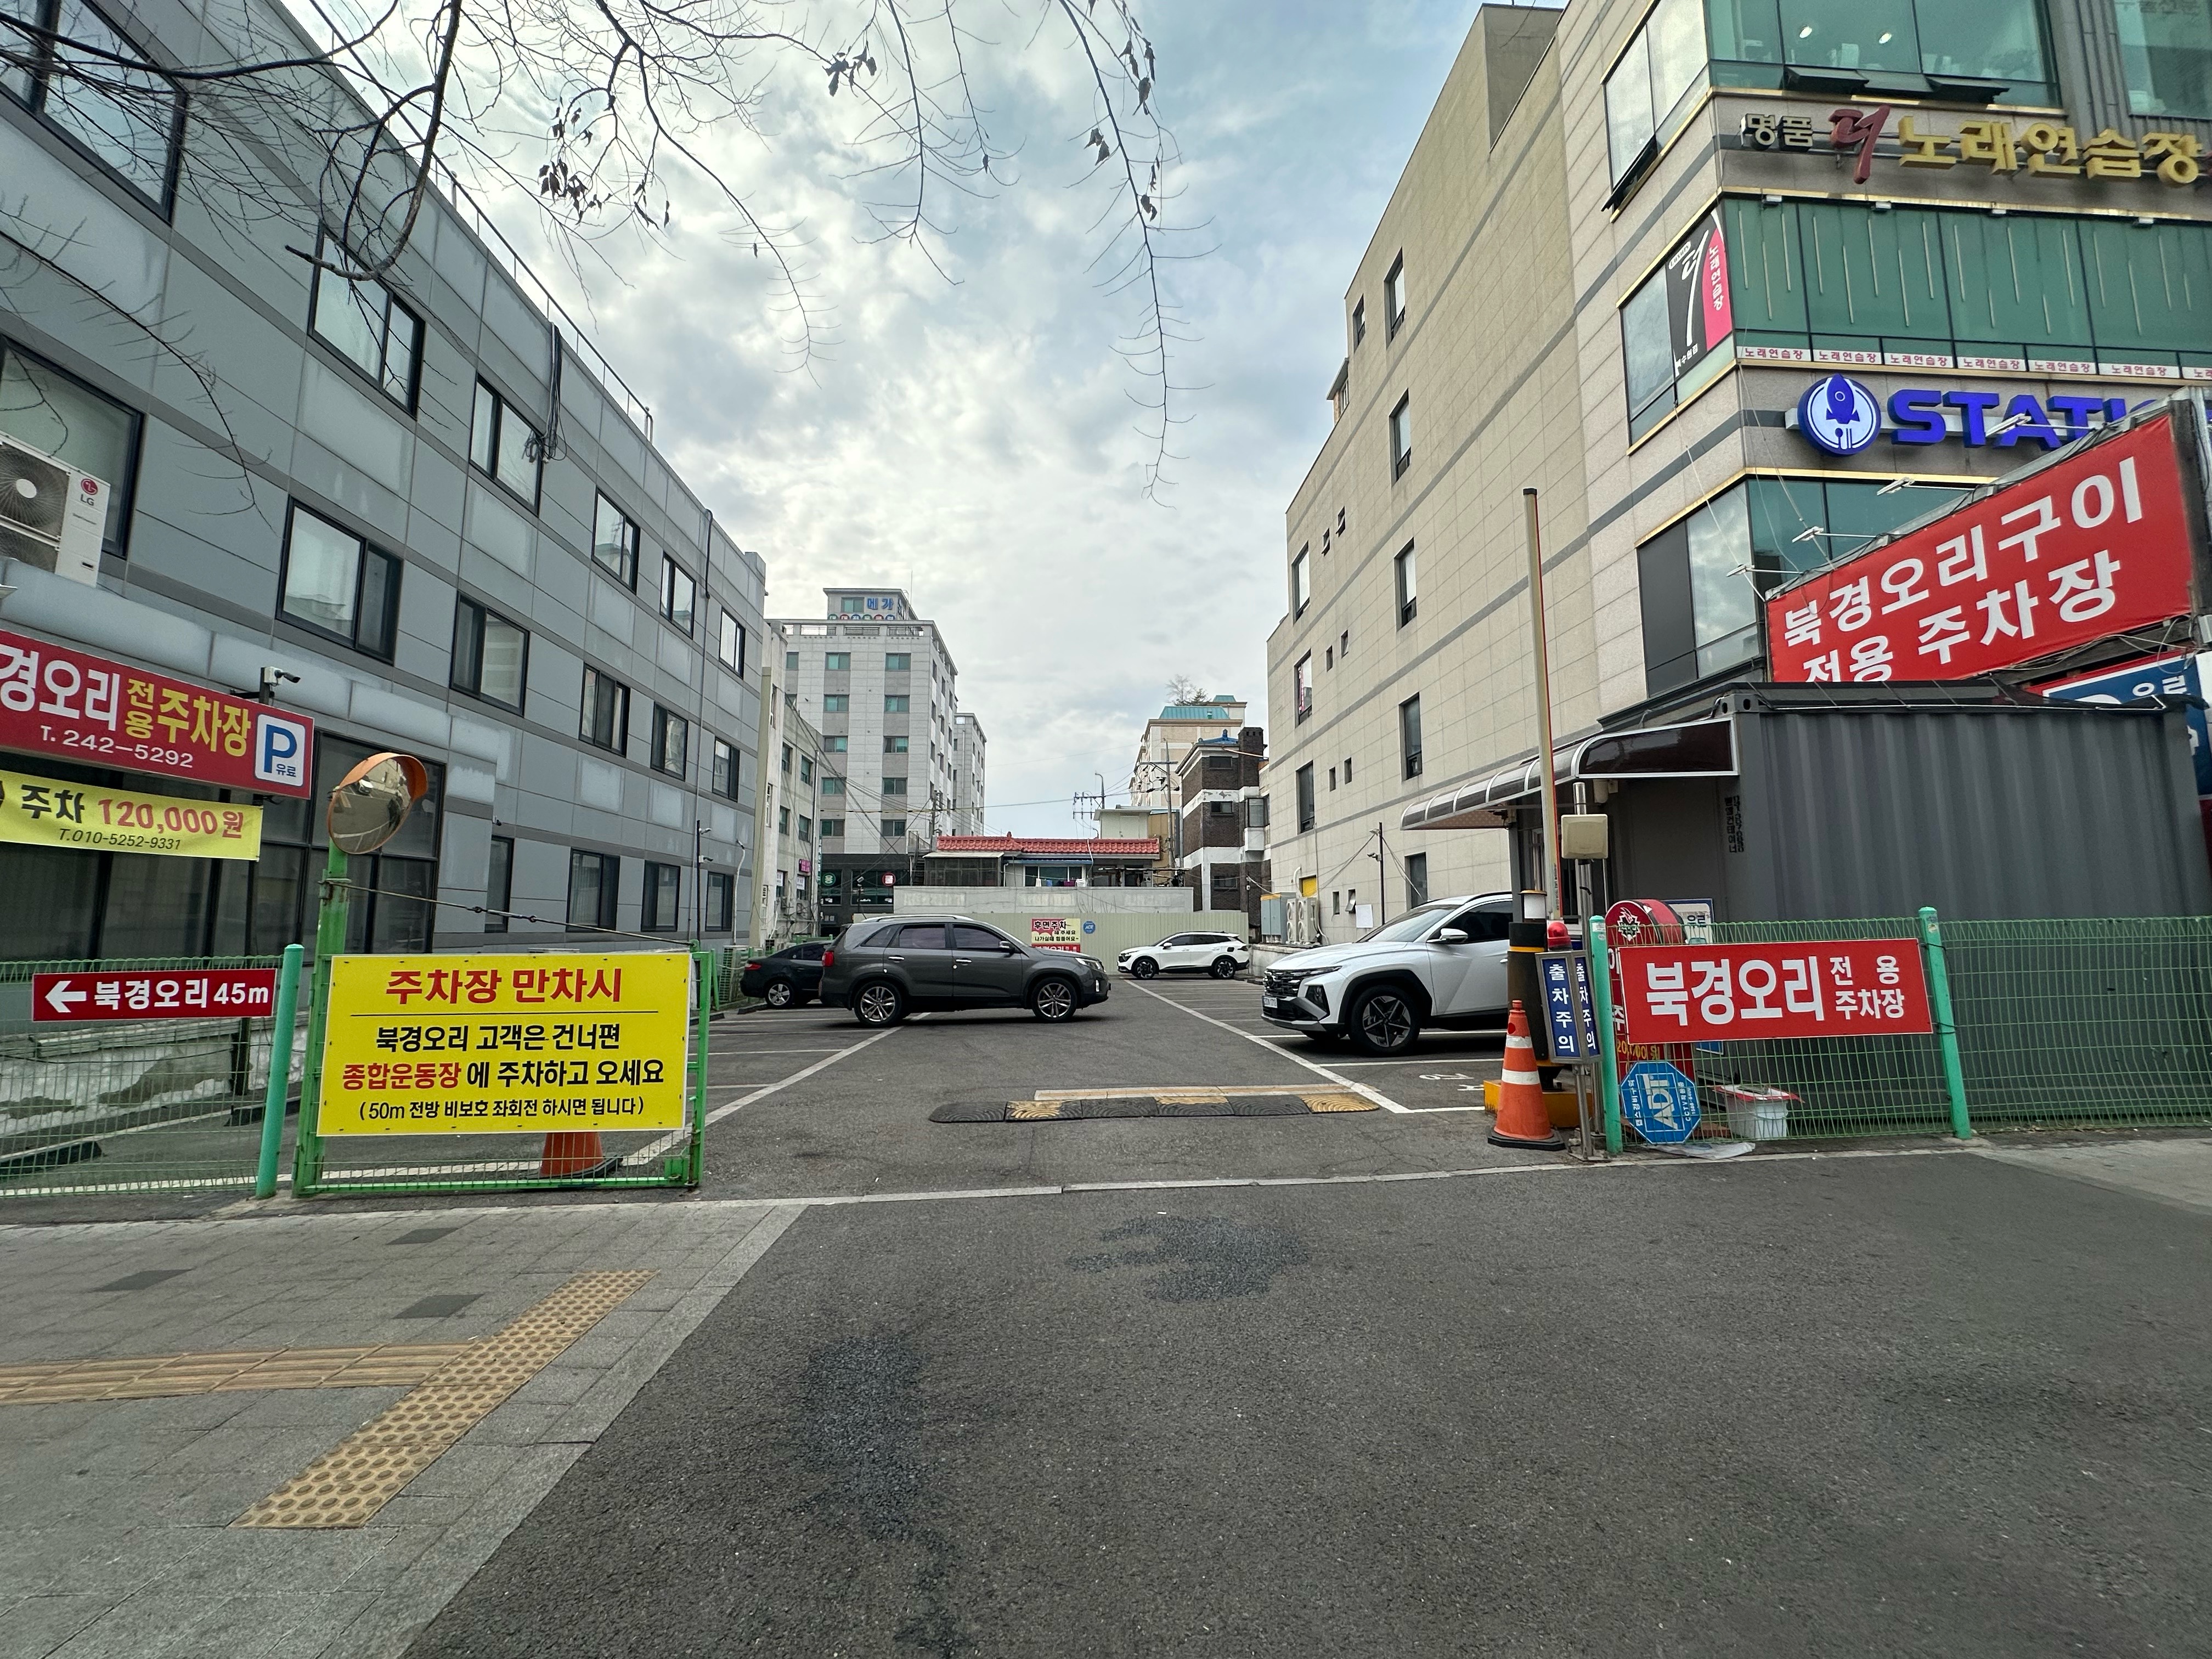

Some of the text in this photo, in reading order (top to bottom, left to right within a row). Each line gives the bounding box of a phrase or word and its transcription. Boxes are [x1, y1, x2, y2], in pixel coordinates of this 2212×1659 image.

[1741, 113, 1814, 152] 명품
[1898, 115, 2202, 187] 노래연습장
[1745, 347, 1803, 360] 노래연습장
[1819, 351, 1877, 363] 노래연습장
[1891, 354, 1948, 367] 노래연습장
[1963, 358, 2020, 370] 노래연습장
[2034, 361, 2091, 373] 노래연습장
[2112, 364, 2167, 377] 노래연습장
[80, 494, 95, 506] LG
[1784, 456, 2144, 648] 북경오리구이
[1917, 550, 2121, 664] 주차장
[0, 644, 119, 731] 경오리
[156, 688, 252, 757] 주차장
[263, 724, 297, 774] P
[275, 763, 297, 778] 유료
[20, 783, 85, 824] 주차
[59, 827, 182, 851] T.010-5252-9331
[1034, 921, 1066, 930] 후면주차
[94, 978, 268, 1010] 북경오리 45m
[385, 967, 622, 1005] 주차장 만차시
[1646, 956, 1825, 1026] 북경오리
[1835, 988, 1905, 1020] 주차장
[1549, 963, 1575, 1053] 출차주의
[1576, 963, 1595, 1050] 출차주의
[376, 1023, 620, 1053] 북경오리 고객은 건너편
[342, 1058, 664, 1091] 종합운동장 에 주차하고 오세요
[409, 1101, 439, 1119] 전방
[443, 1100, 489, 1119] 비보호
[492, 1099, 538, 1118] 좌회전
[542, 1098, 587, 1116] 하시면
[1642, 1073, 1678, 1130] ADT
